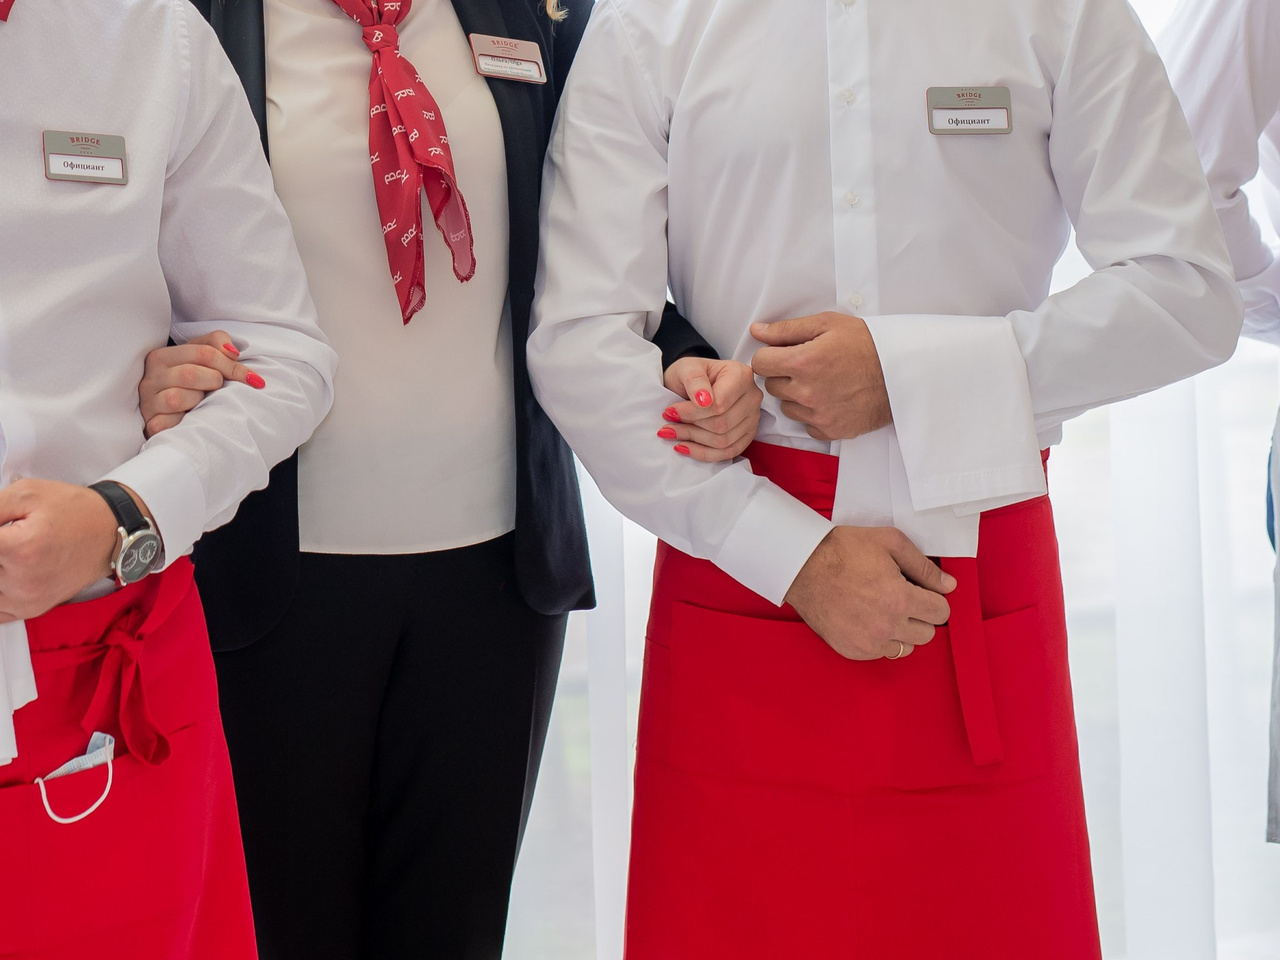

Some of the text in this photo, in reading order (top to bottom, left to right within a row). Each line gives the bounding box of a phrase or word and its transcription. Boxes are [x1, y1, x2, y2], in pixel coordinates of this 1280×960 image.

[491, 40, 520, 49] BRIDGE
[947, 117, 991, 127] Официант
[69, 136, 101, 145] BRIDGE
[63, 160, 105, 172] Официант
